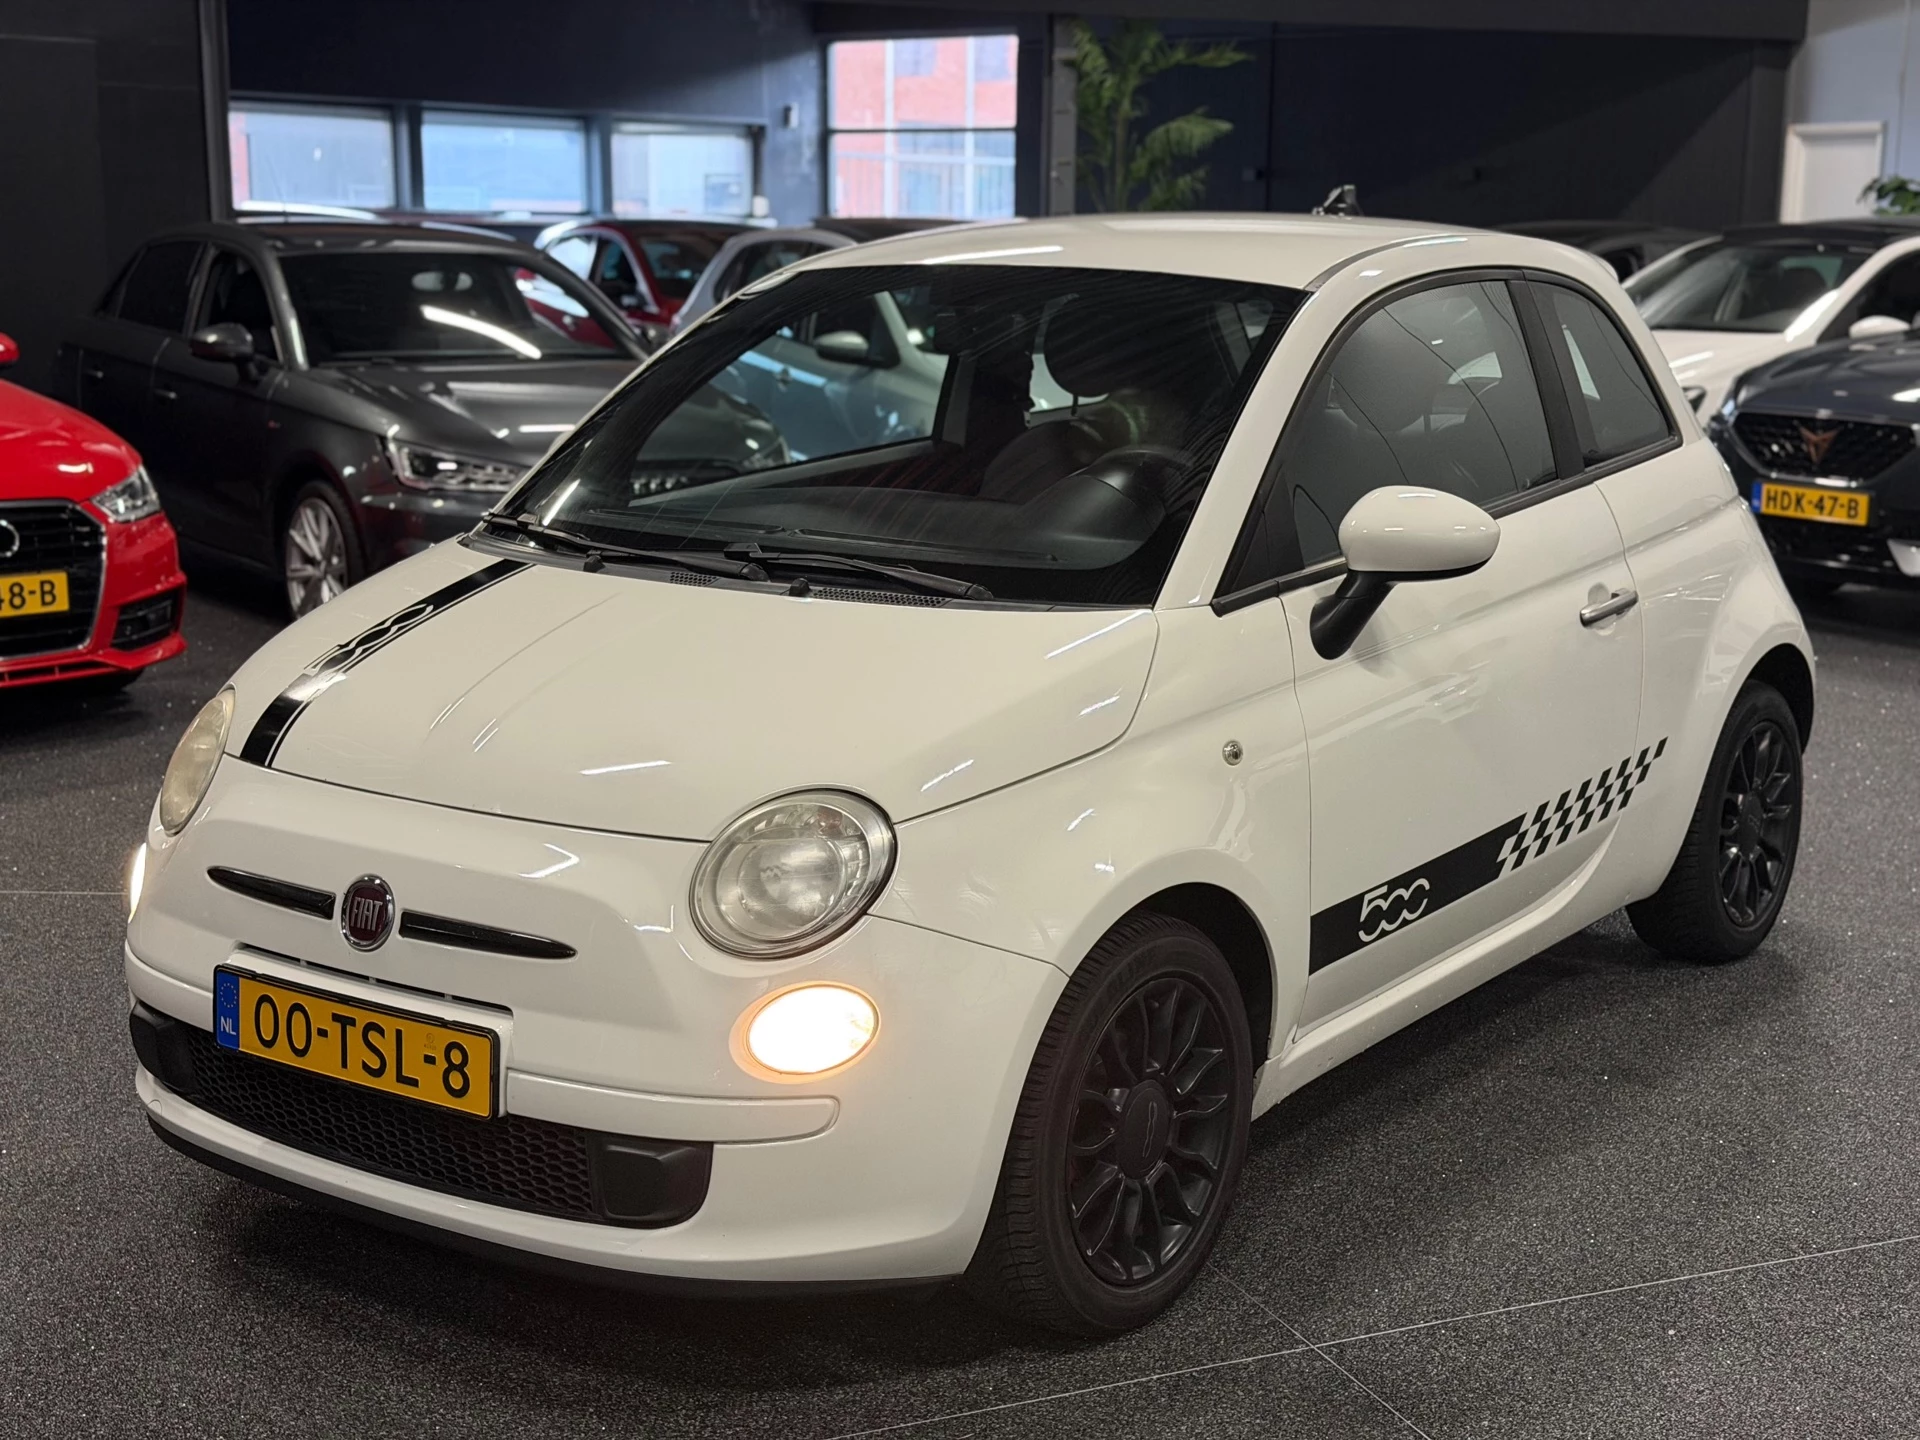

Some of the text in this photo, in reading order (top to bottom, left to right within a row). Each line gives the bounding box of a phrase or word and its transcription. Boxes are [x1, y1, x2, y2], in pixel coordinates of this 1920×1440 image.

[1765, 488, 1859, 519] HDK-47-B
[0, 580, 57, 611] 8-B
[350, 896, 383, 931] FIAT
[1358, 877, 1430, 943] 500
[220, 1016, 237, 1036] NL
[254, 993, 471, 1099] 00-TSL-8
